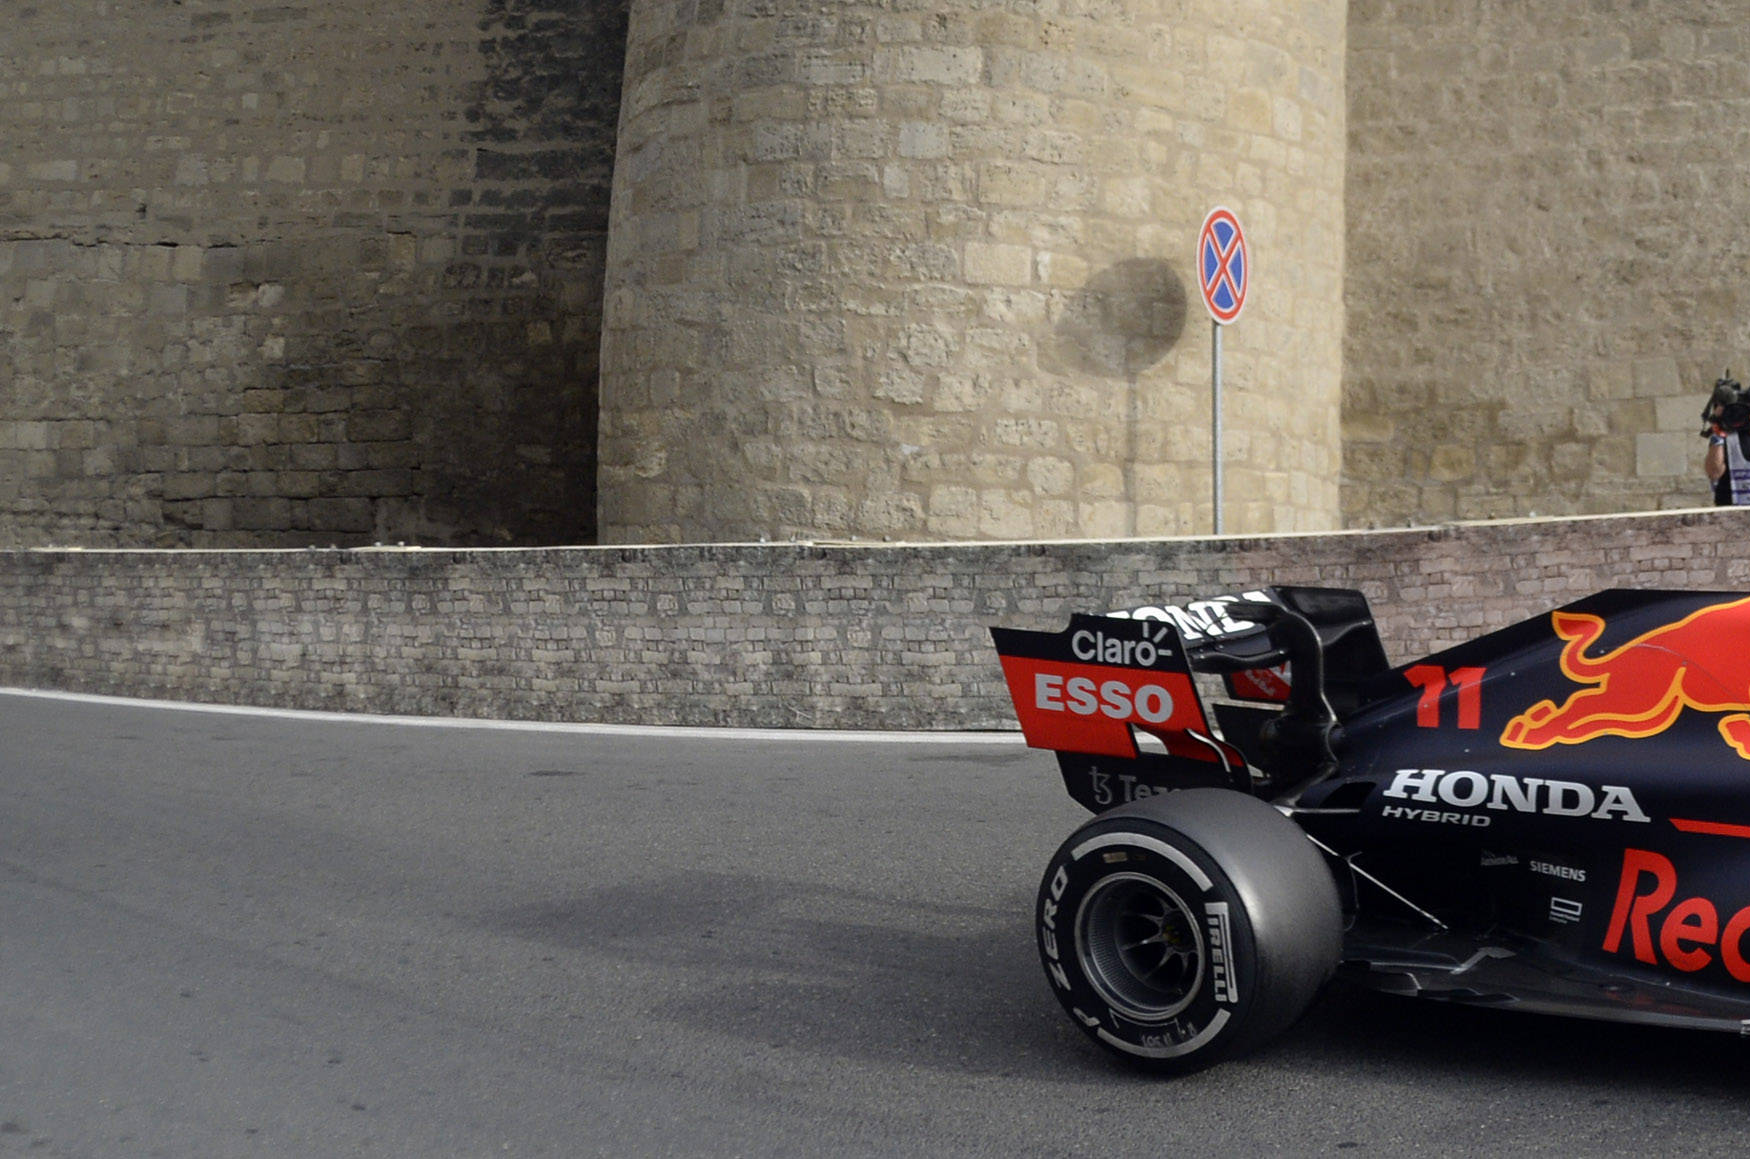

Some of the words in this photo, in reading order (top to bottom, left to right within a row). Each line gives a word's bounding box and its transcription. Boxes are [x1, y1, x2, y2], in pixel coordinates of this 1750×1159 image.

[1072, 629, 1157, 668] Claro
[1035, 673, 1174, 723] ESSO
[1403, 665, 1487, 730] 11
[1382, 805, 1491, 827] HYBRID
[1383, 769, 1651, 823] HONDA
[1529, 860, 1586, 882] SIEMENS
[1042, 865, 1071, 991] ZERO
[1204, 901, 1239, 1003] PIRELLI
